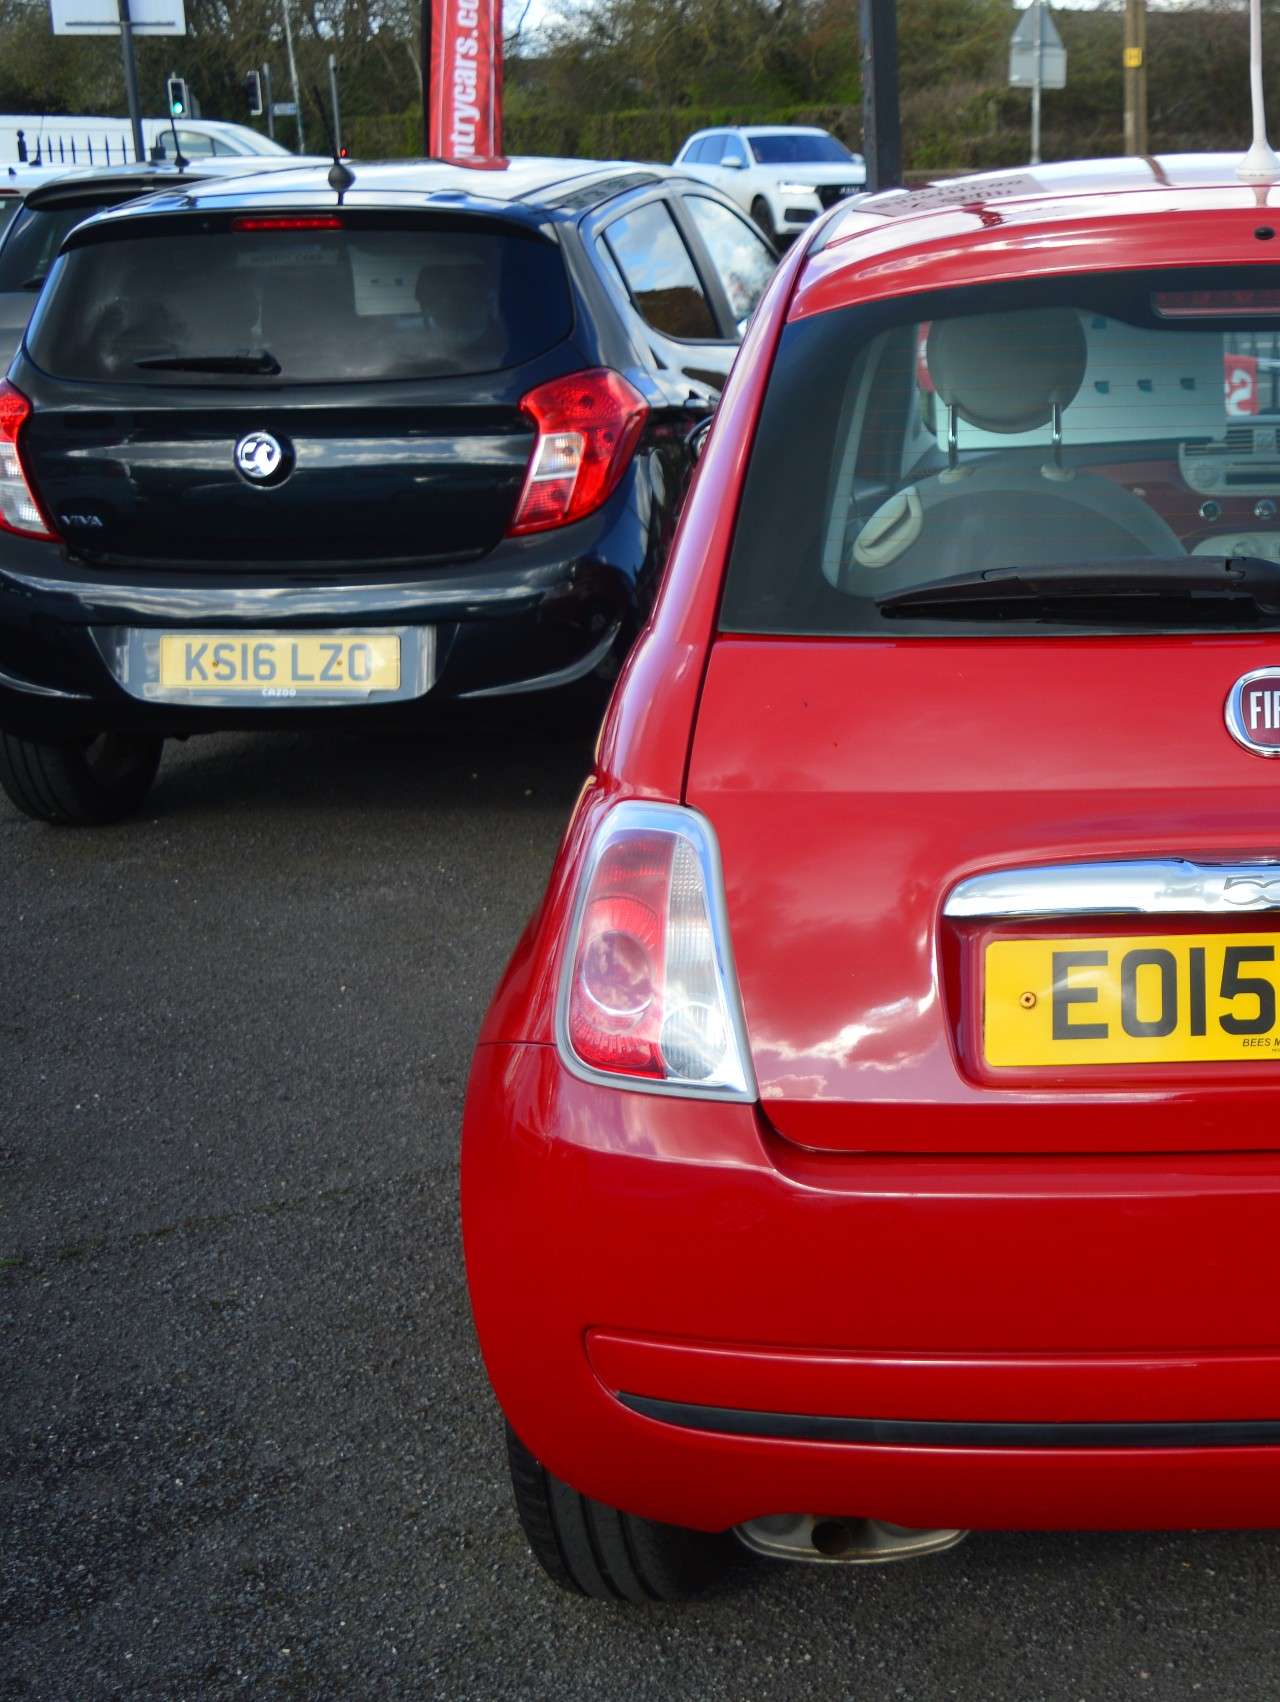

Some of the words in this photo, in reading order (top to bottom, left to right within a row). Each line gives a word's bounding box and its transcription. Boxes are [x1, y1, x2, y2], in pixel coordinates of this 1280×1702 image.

[184, 643, 277, 681] KS16
[1051, 944, 1277, 1040] EO15
[1242, 1038, 1271, 1047] BEES
